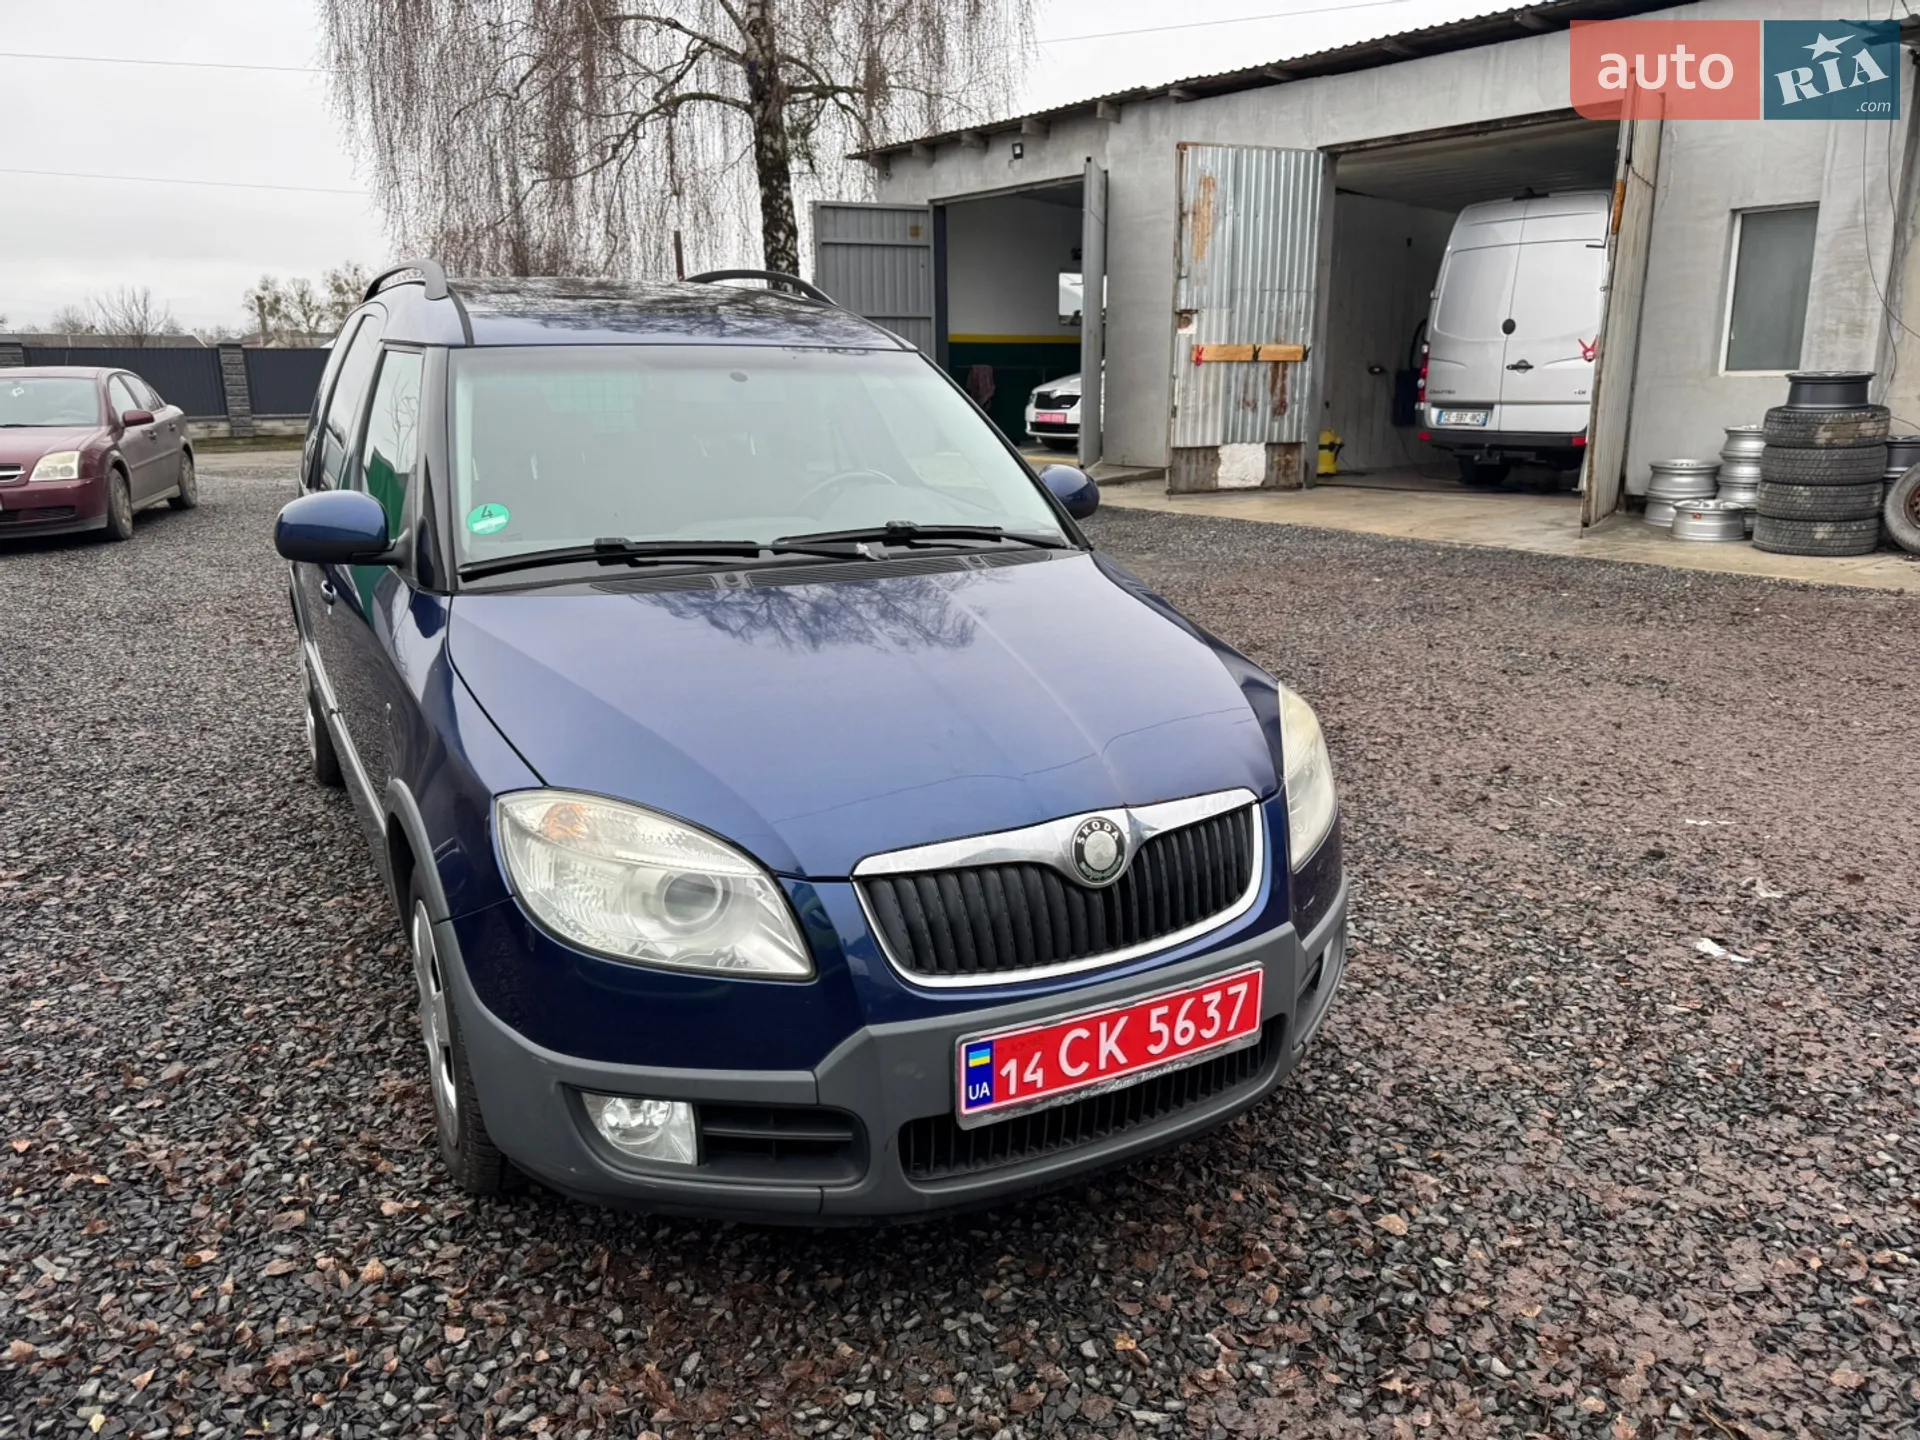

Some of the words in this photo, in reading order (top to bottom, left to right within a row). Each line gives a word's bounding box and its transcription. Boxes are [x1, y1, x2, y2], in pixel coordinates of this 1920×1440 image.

[481, 505, 493, 518] 4
[1000, 1051, 1044, 1095] 14
[1058, 1016, 1129, 1077] CK
[1147, 982, 1249, 1055] 5637
[968, 1081, 991, 1100] UA
